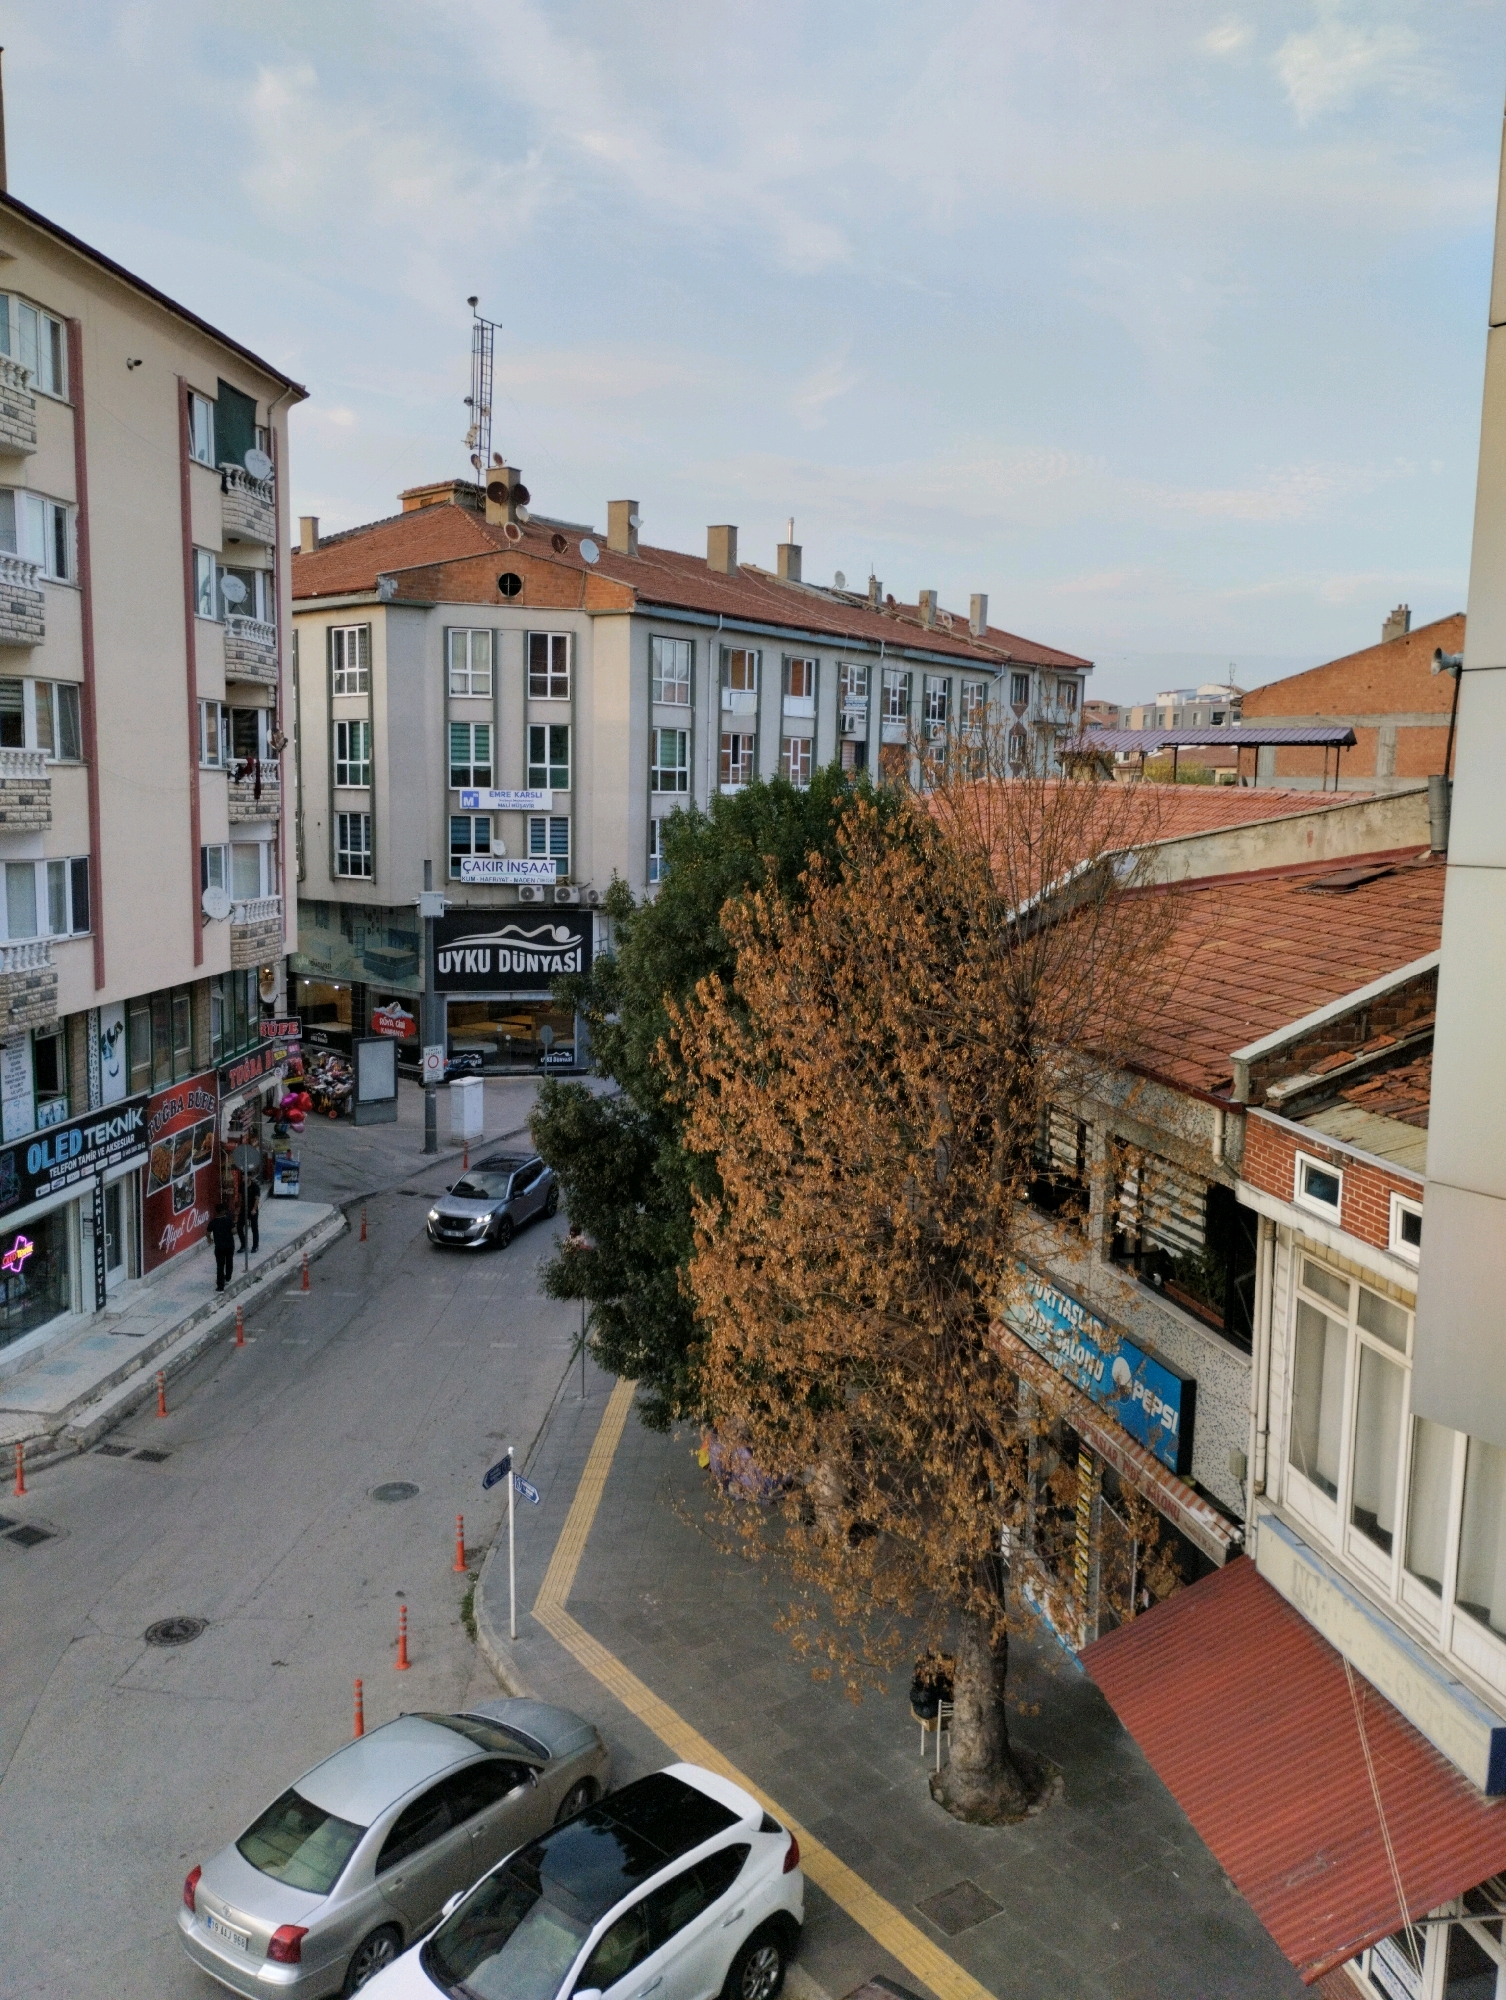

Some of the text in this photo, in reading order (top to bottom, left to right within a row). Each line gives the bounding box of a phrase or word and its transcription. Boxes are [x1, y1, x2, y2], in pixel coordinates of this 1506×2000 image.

[514, 791, 543, 799] KARSLI
[462, 860, 556, 875] ÇAKIR İNŞAAT
[438, 949, 491, 973] UYKU
[229, 1055, 263, 1089] TUĞBA
[148, 1086, 216, 1142] TUĞBA BÜFE
[27, 1107, 143, 1175] OLED TEKNİK
[49, 1159, 77, 1178] TELEFON
[77, 1149, 97, 1167] TAMİR
[97, 1147, 105, 1158] VE
[105, 1133, 135, 1154] AKSESUAR
[186, 1208, 209, 1233] Olsun
[1131, 1380, 1179, 1435] PEPSI
